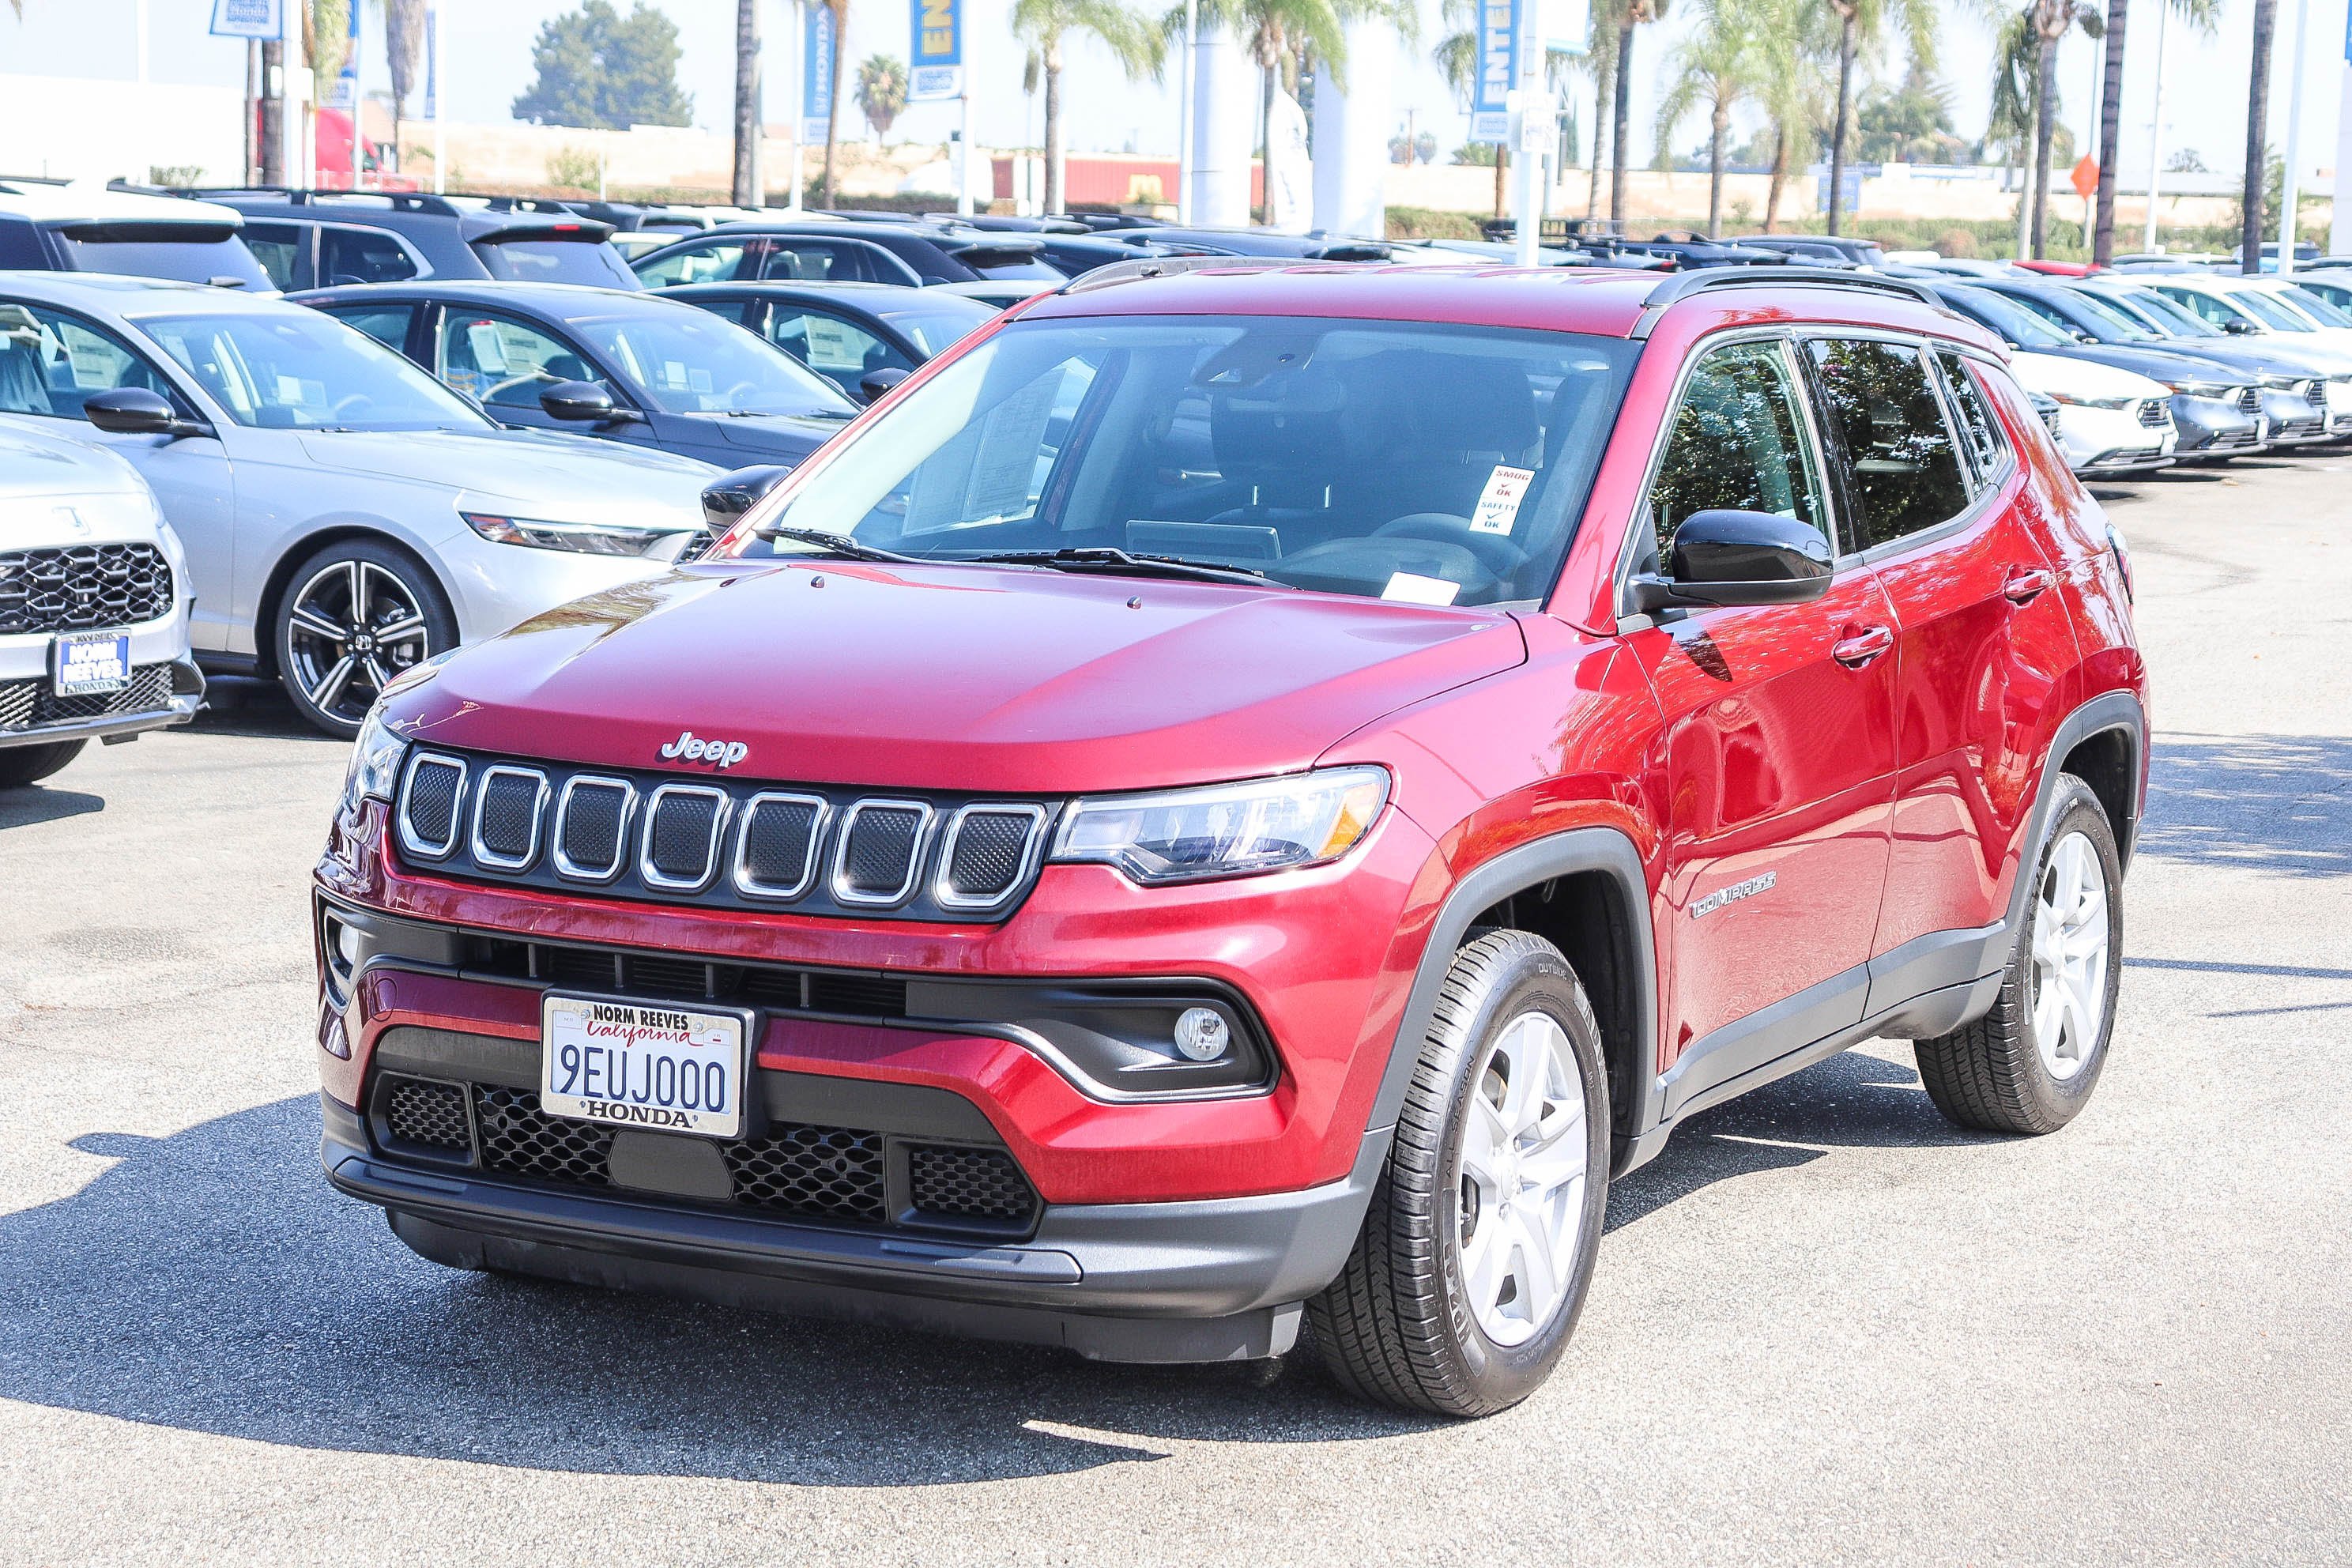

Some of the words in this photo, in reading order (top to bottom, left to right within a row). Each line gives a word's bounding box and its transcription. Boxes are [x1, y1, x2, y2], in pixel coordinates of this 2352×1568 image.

[1496, 470, 1529, 481] SMOG
[1480, 501, 1516, 511] SAFETY
[1496, 488, 1512, 497] OK
[62, 658, 122, 683] REEVES
[662, 731, 748, 768] Jeep
[1689, 870, 1777, 920] COMPASS
[594, 1004, 635, 1025] NORM
[640, 1010, 689, 1031] REEVES
[586, 1020, 704, 1048] California
[559, 1044, 726, 1113] 9EUJ000
[1451, 1054, 1475, 1133] SEASON
[586, 1100, 693, 1129] HONDA
[1446, 1143, 1457, 1178] ALL
